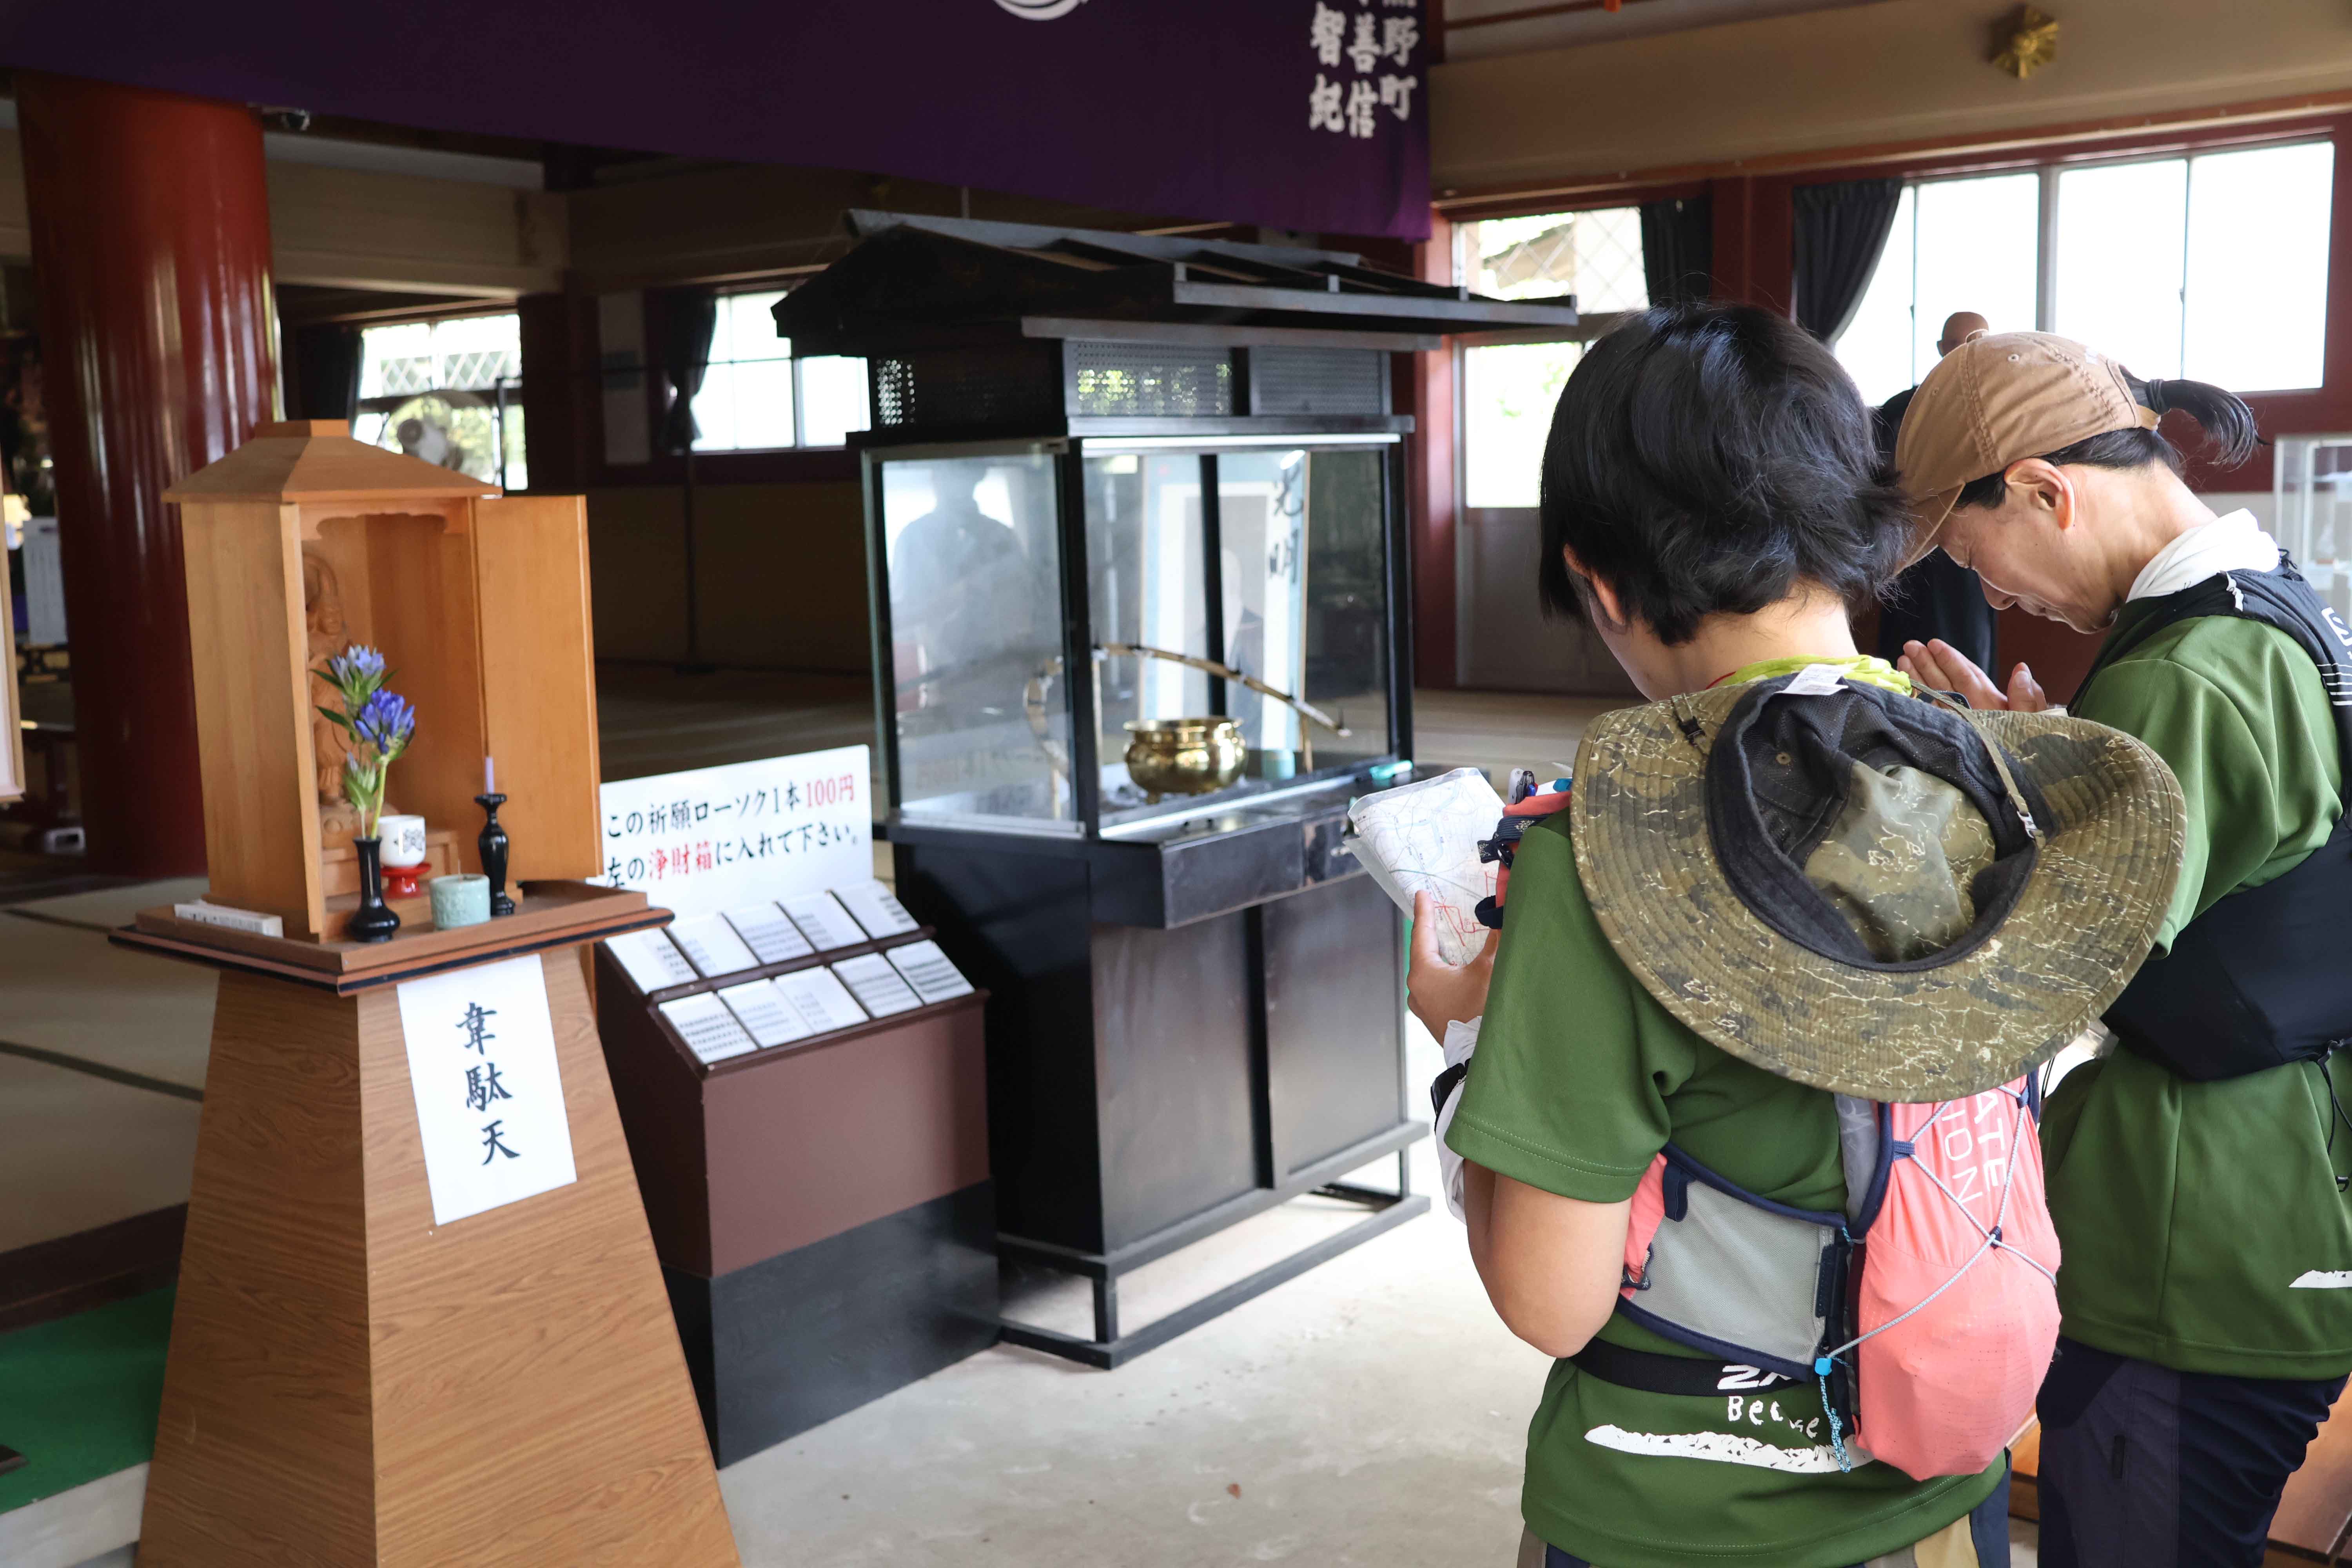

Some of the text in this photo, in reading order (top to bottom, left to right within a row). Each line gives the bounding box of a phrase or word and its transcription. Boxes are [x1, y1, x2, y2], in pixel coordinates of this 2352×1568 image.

[1346, 0, 1382, 139] 善信
[1379, 0, 1420, 121] 野町
[456, 1002, 521, 1166] 韋駄天
